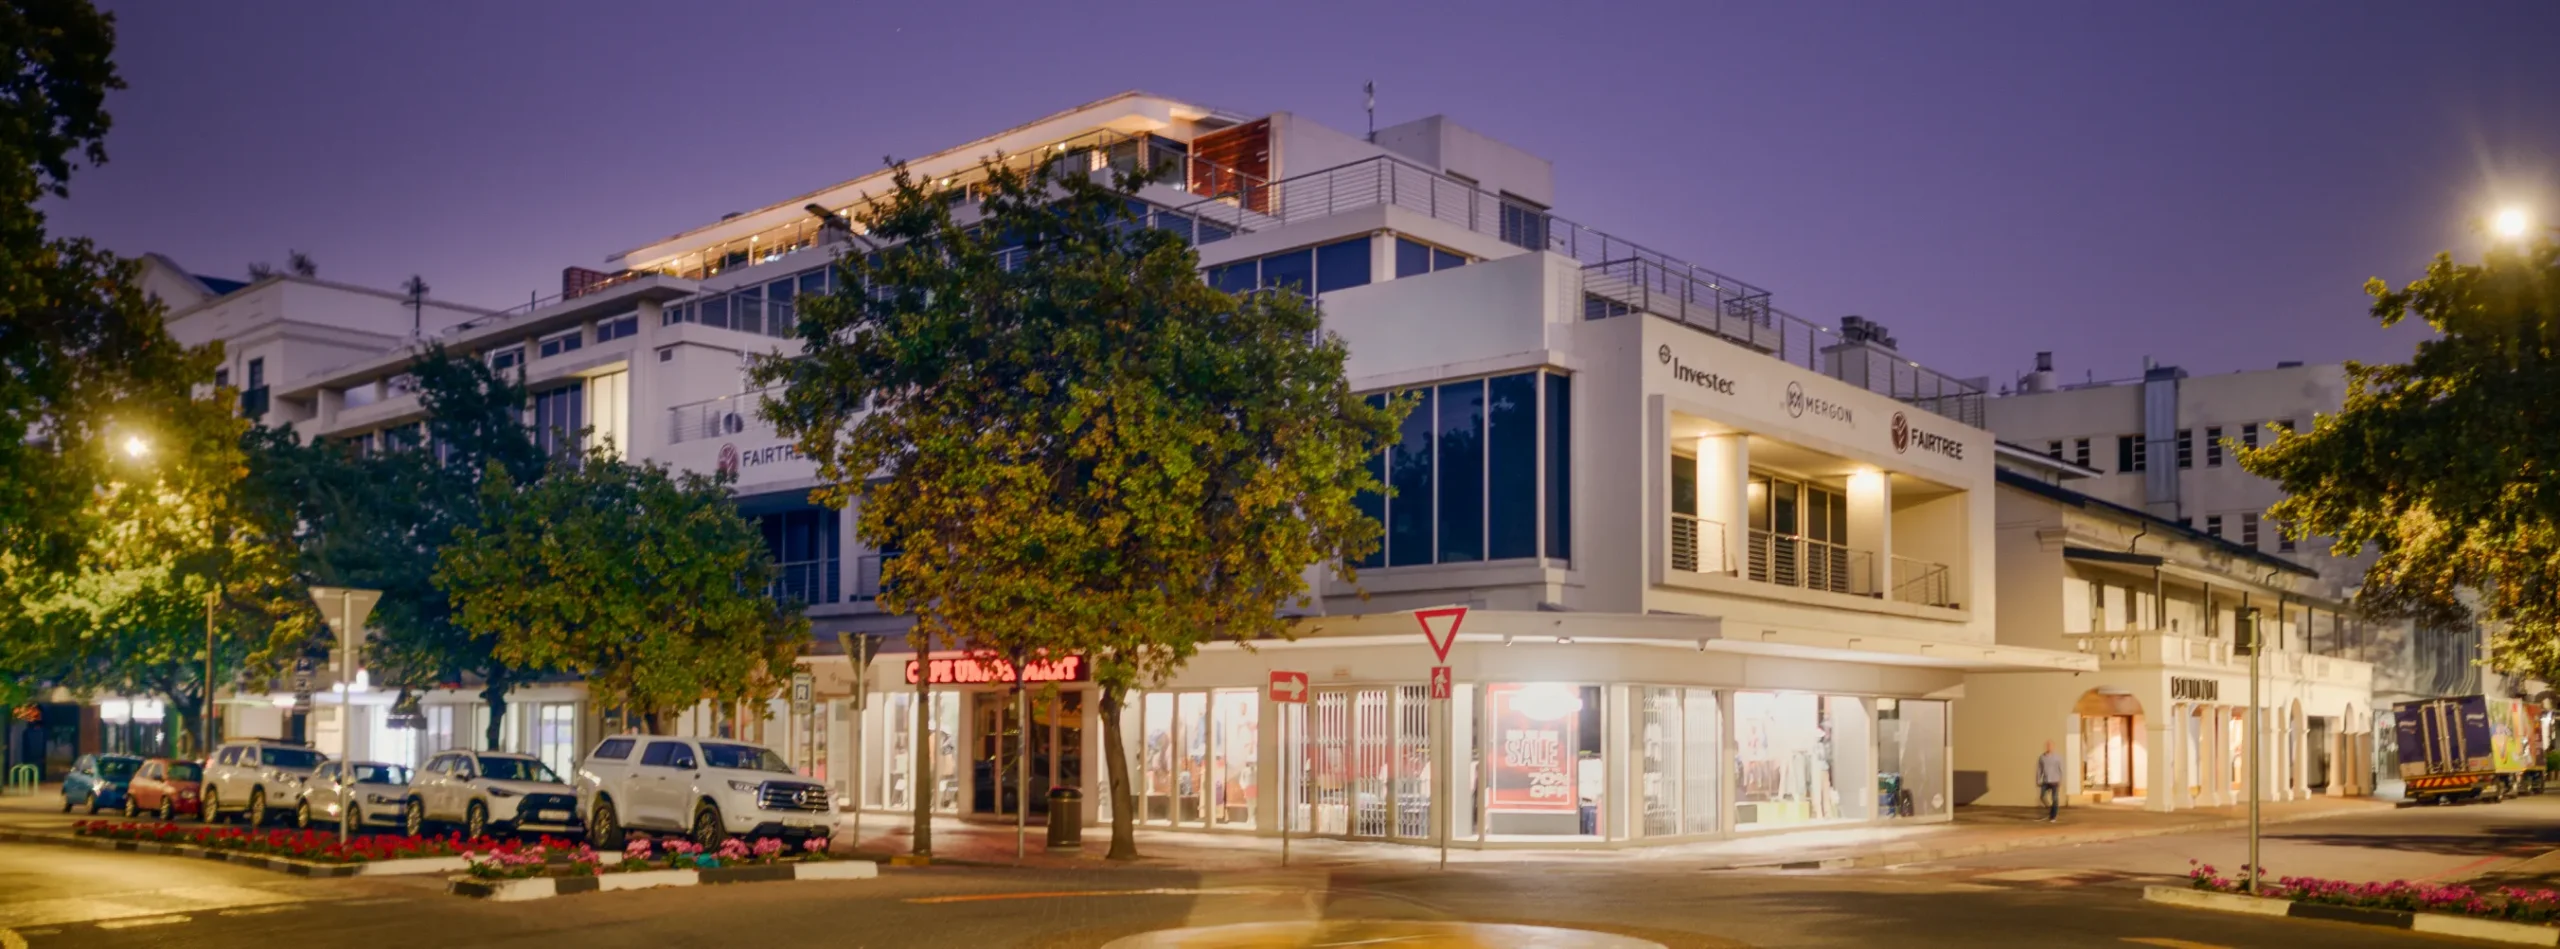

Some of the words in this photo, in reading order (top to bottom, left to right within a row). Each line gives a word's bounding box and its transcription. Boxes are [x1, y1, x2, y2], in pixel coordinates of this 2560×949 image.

[1673, 357, 1735, 395] Investec
[1805, 396, 1853, 423] MERGON
[742, 444, 807, 467] FAIRTR
[1911, 427, 1964, 460] FAIRTREE
[906, 660, 952, 683] CPE
[1505, 740, 1559, 767] SALE
[1530, 785, 1568, 798] OFF
